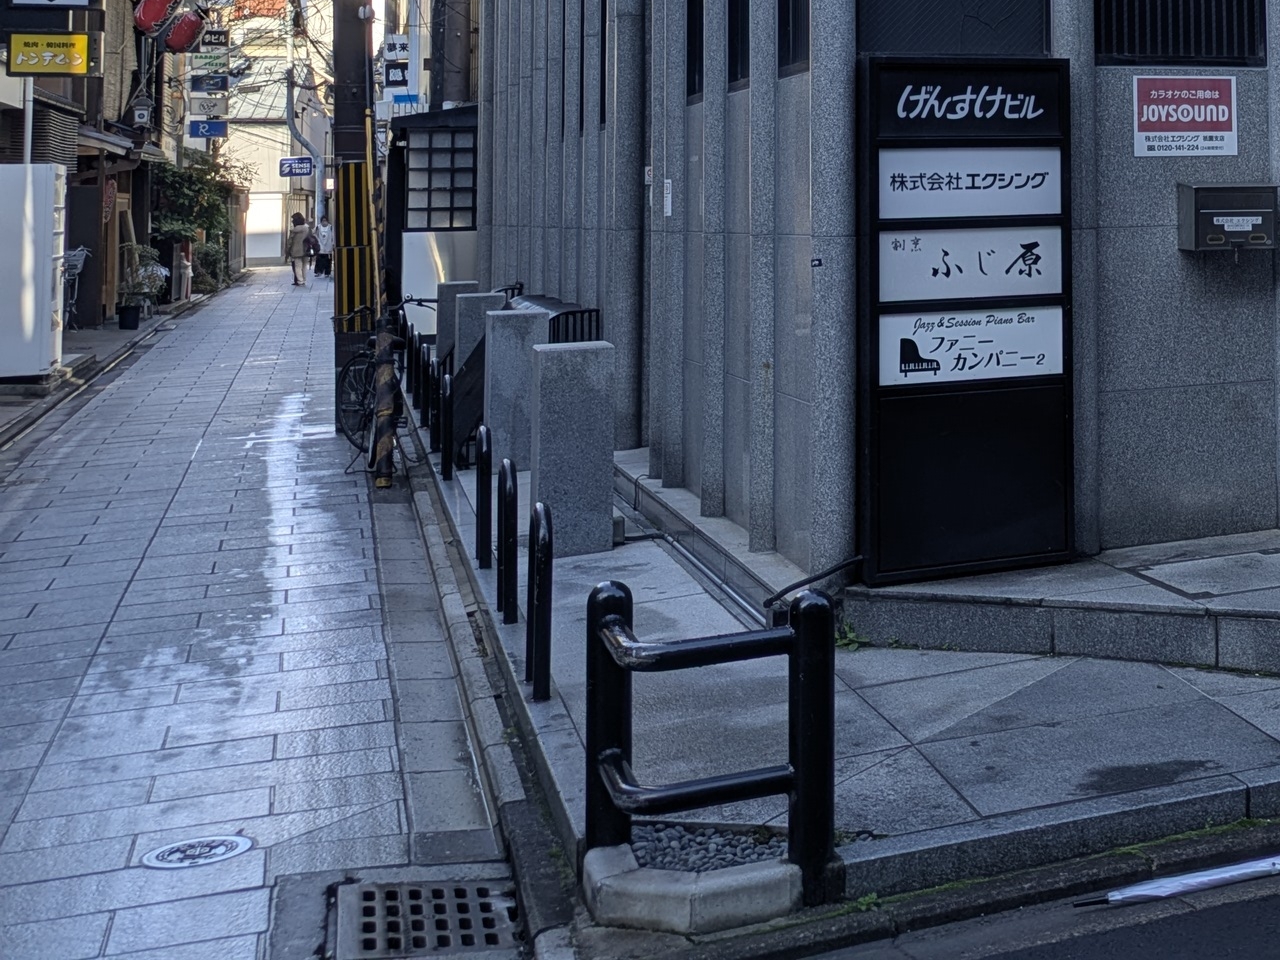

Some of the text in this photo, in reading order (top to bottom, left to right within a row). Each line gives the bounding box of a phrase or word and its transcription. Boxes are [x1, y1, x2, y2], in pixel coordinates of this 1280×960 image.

[897, 85, 1044, 119] げんすけビル
[1150, 90, 1219, 99] カラオケのご用命は
[1141, 104, 1229, 122] JOYSOUND
[890, 172, 1049, 191] 株式会社エクシング
[932, 241, 1042, 278] ふじ原
[985, 314, 1013, 327] Piano
[1017, 312, 1035, 324] Bar
[930, 335, 994, 354] ファニー
[951, 349, 1046, 372] カンパニー2
